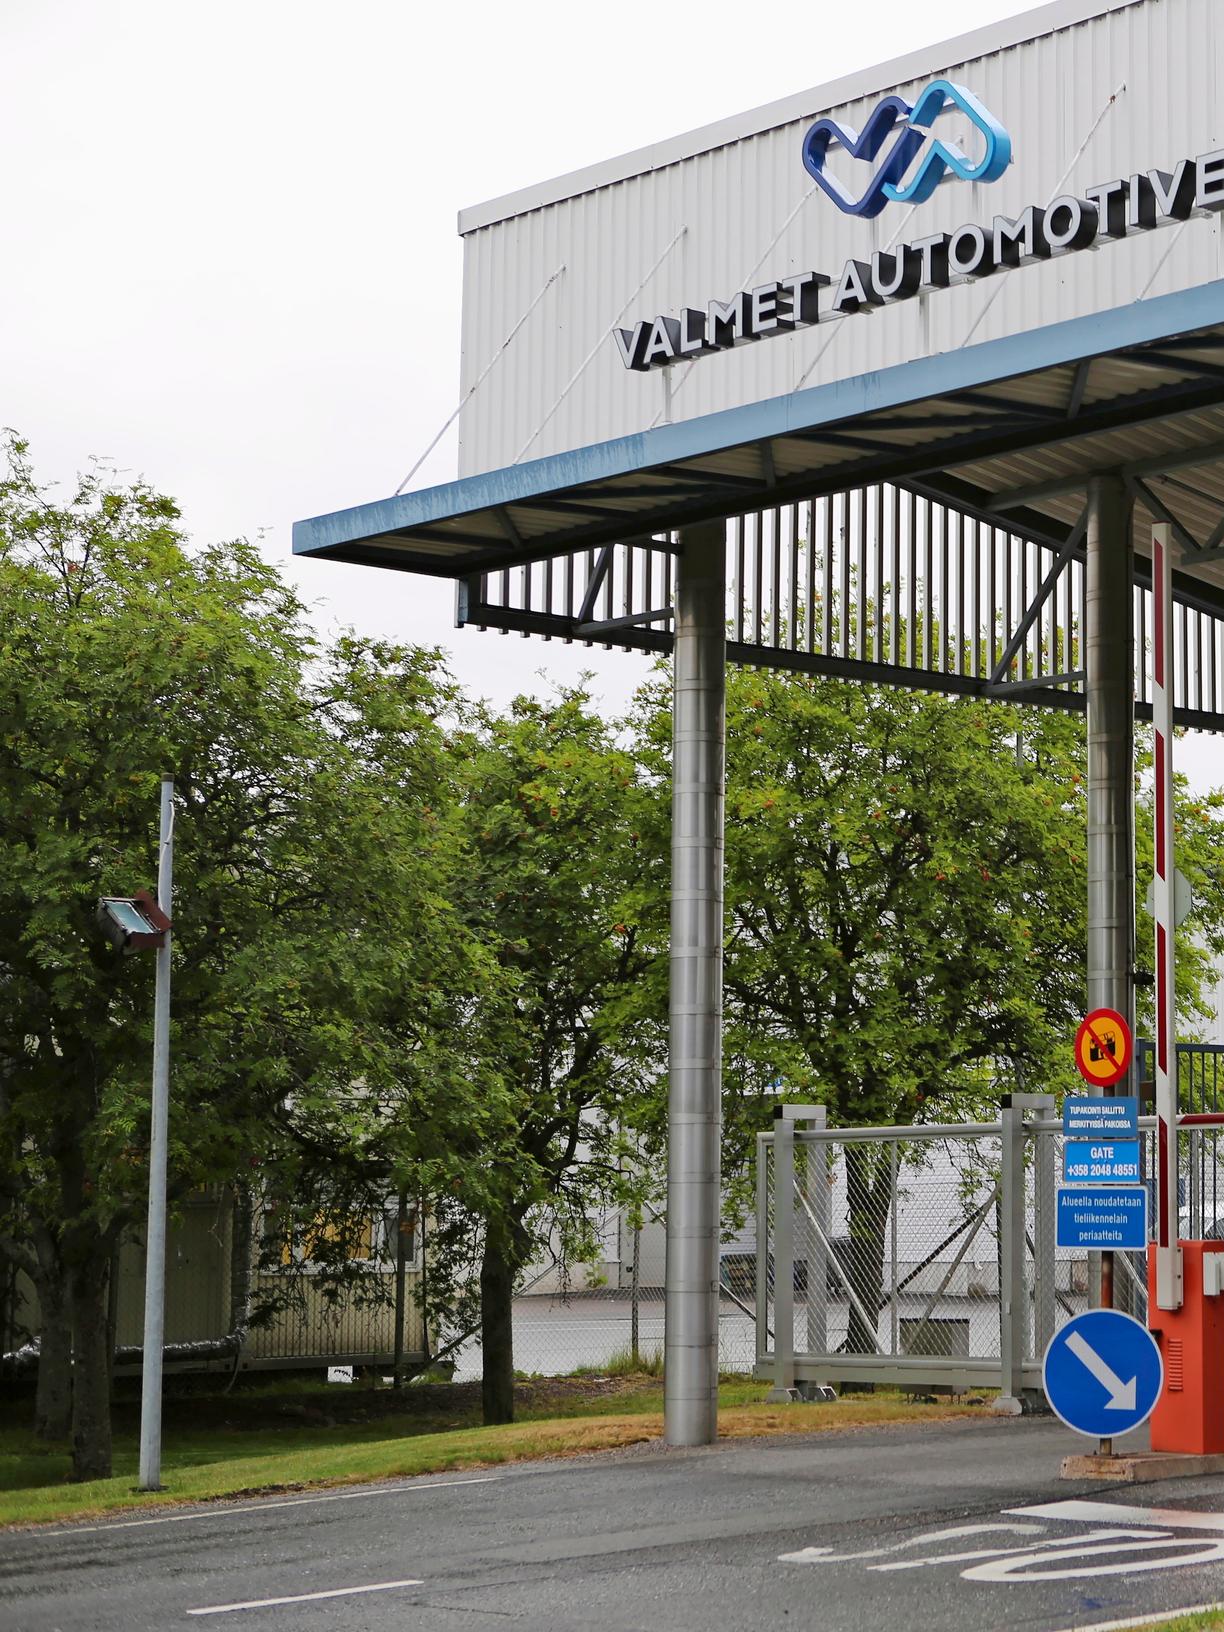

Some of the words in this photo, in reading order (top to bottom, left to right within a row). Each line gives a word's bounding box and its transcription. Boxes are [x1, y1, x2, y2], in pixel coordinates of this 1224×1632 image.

[613, 271, 830, 371] VALMET
[1069, 1106, 1101, 1115] TUPAKOINTI
[1102, 1106, 1125, 1115] SALLITTU
[1104, 1119, 1131, 1128] PAIKOISSA
[1090, 1147, 1114, 1159] GATE
[1068, 1164, 1089, 1176] +358
[1090, 1164, 1111, 1176] 2048
[1112, 1164, 1137, 1176] 48551
[1062, 1196, 1092, 1207] Alueella
[1094, 1196, 1141, 1207] noudatetaan
[1074, 1212, 1128, 1223] tieliikennelain
[1079, 1230, 1122, 1242] periaatteita
